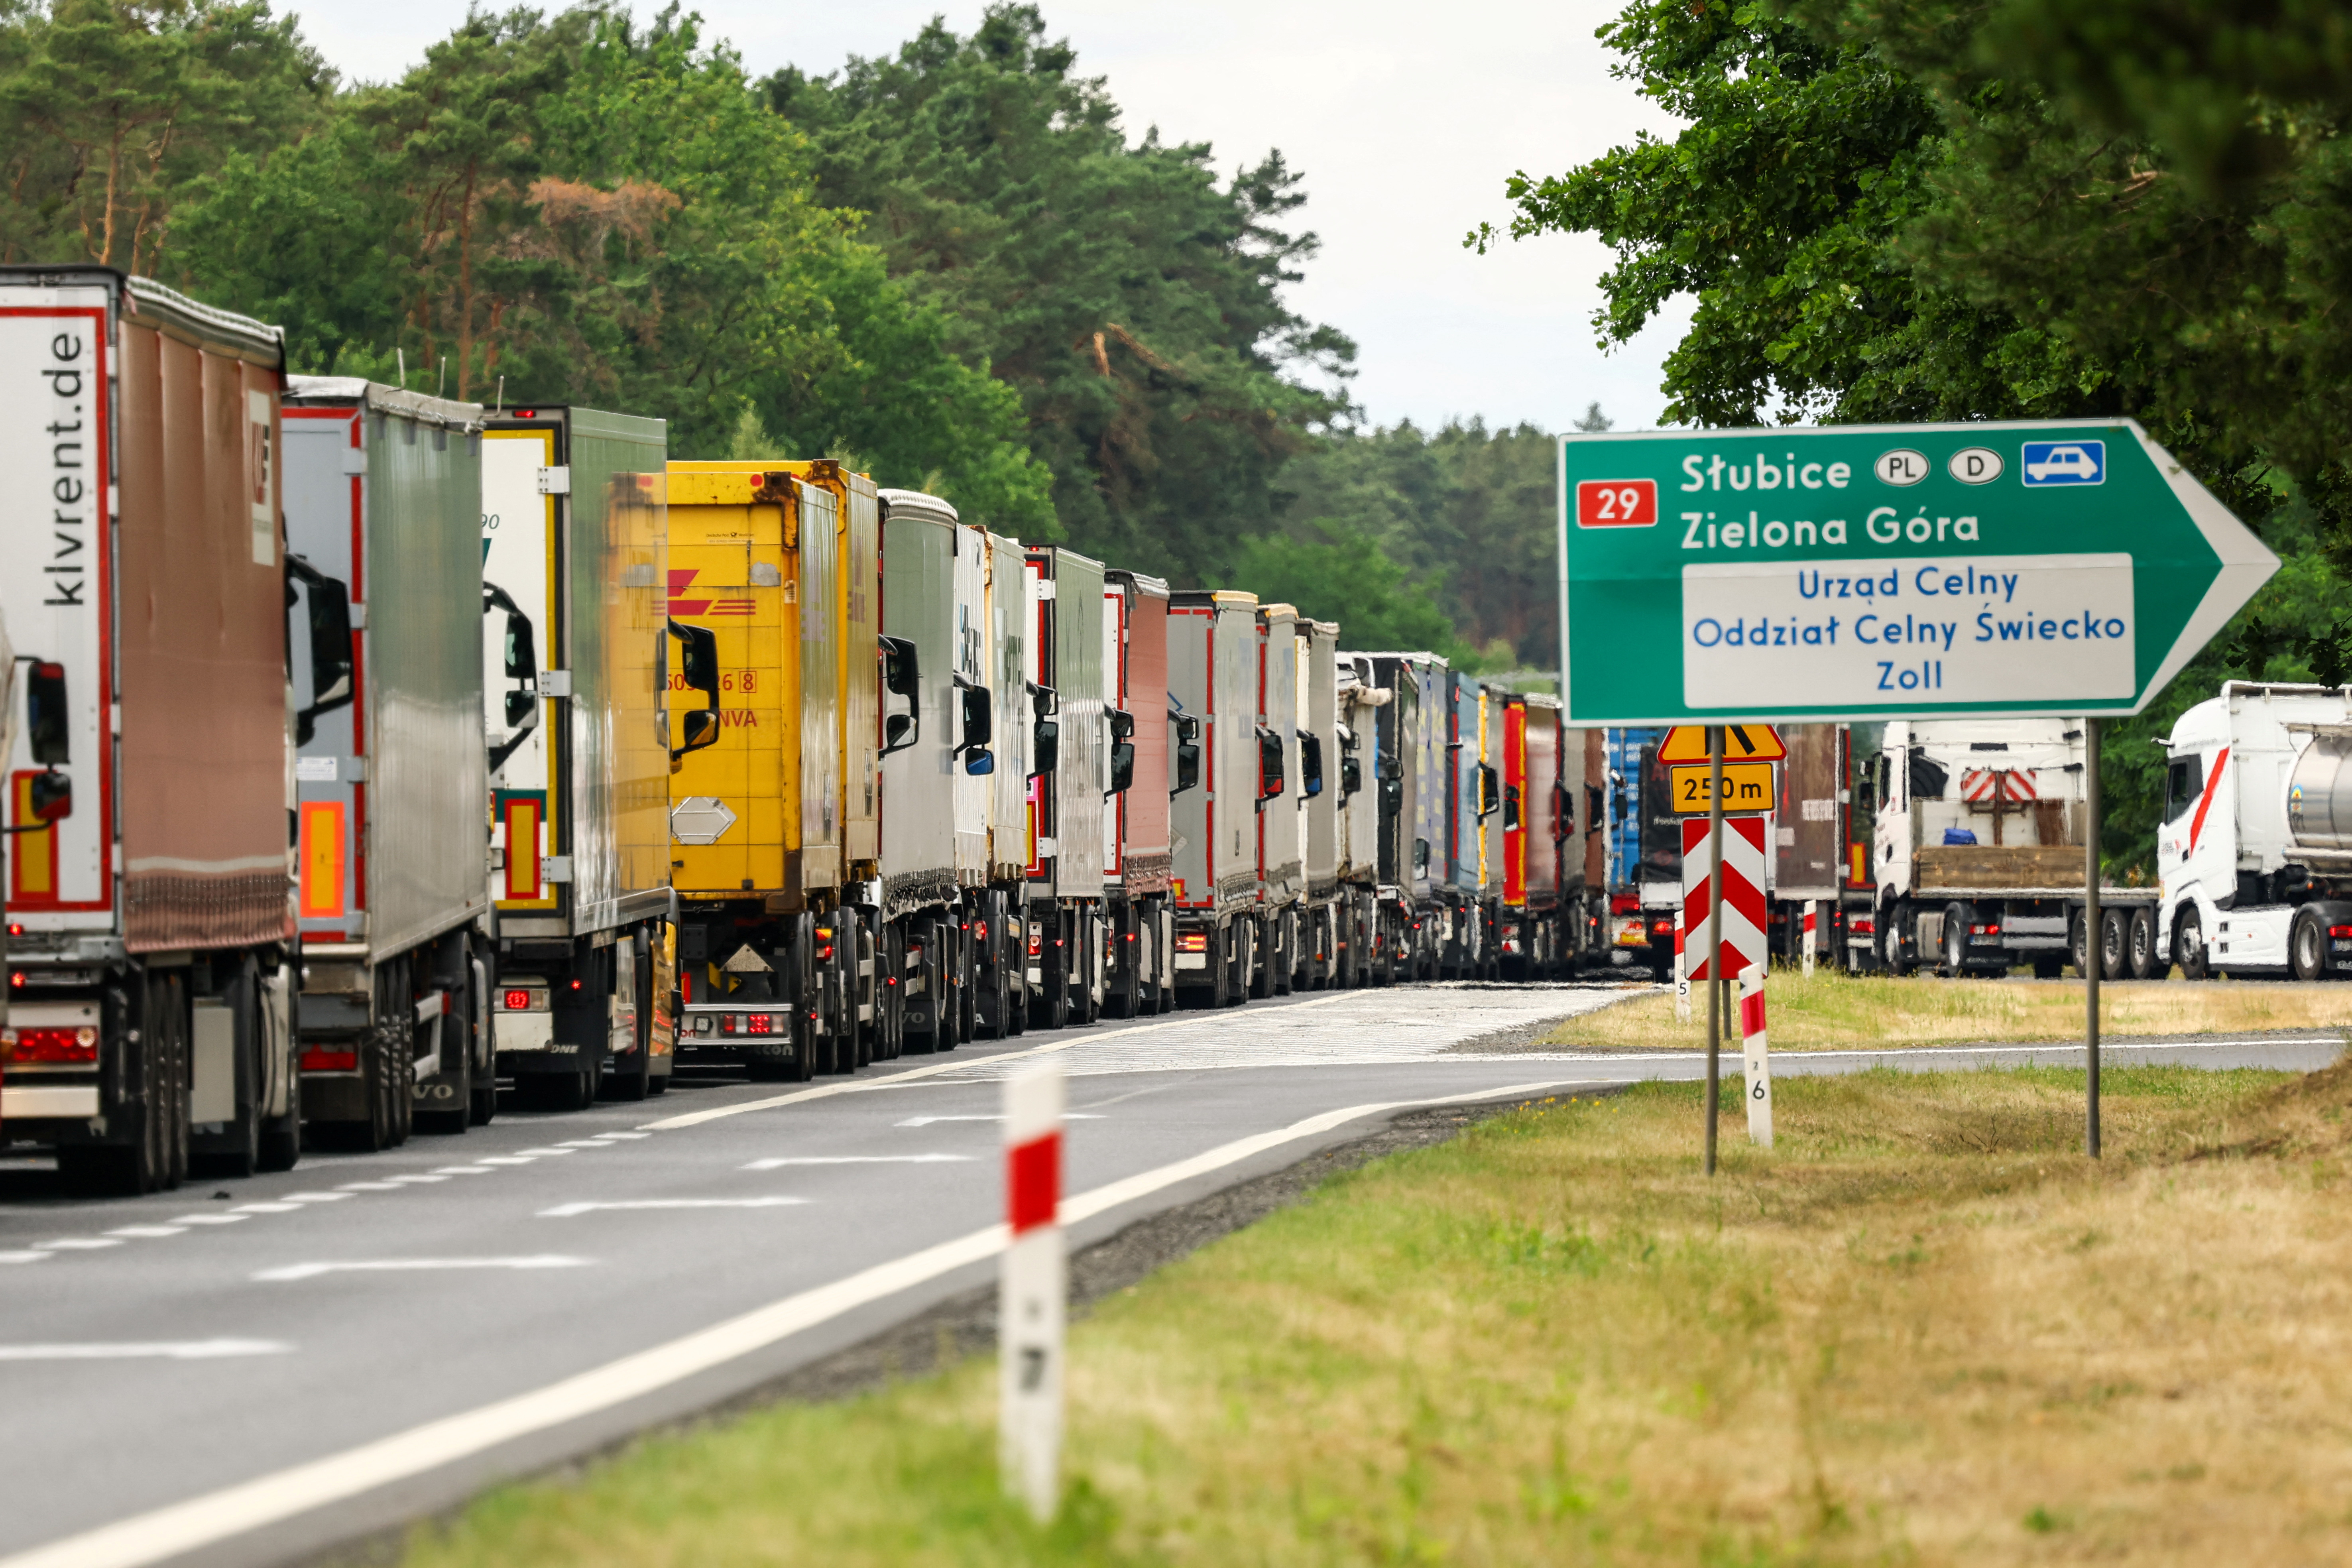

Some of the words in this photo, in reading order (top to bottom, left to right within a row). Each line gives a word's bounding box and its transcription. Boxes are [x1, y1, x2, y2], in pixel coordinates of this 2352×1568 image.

[42, 333, 84, 606] klvrent.de
[1681, 453, 1851, 492] Słubice
[1889, 458, 1916, 478] PL
[1967, 456, 1985, 476] D
[1597, 488, 1640, 520] 29
[1681, 511, 1847, 549] Zielona
[1866, 506, 1979, 543] Góra
[1799, 568, 1899, 605] Urząd
[1915, 566, 2018, 602] Celny
[1693, 616, 1840, 648] Oddział
[1854, 614, 1957, 652] Celny
[1975, 602, 2126, 642] Świecko
[743, 673, 754, 691] 8
[1877, 660, 1942, 690] Zoll
[1684, 777, 1734, 800] 250
[1740, 783, 1761, 799] m
[1679, 982, 1687, 995] 5
[1753, 1080, 1765, 1100] 6
